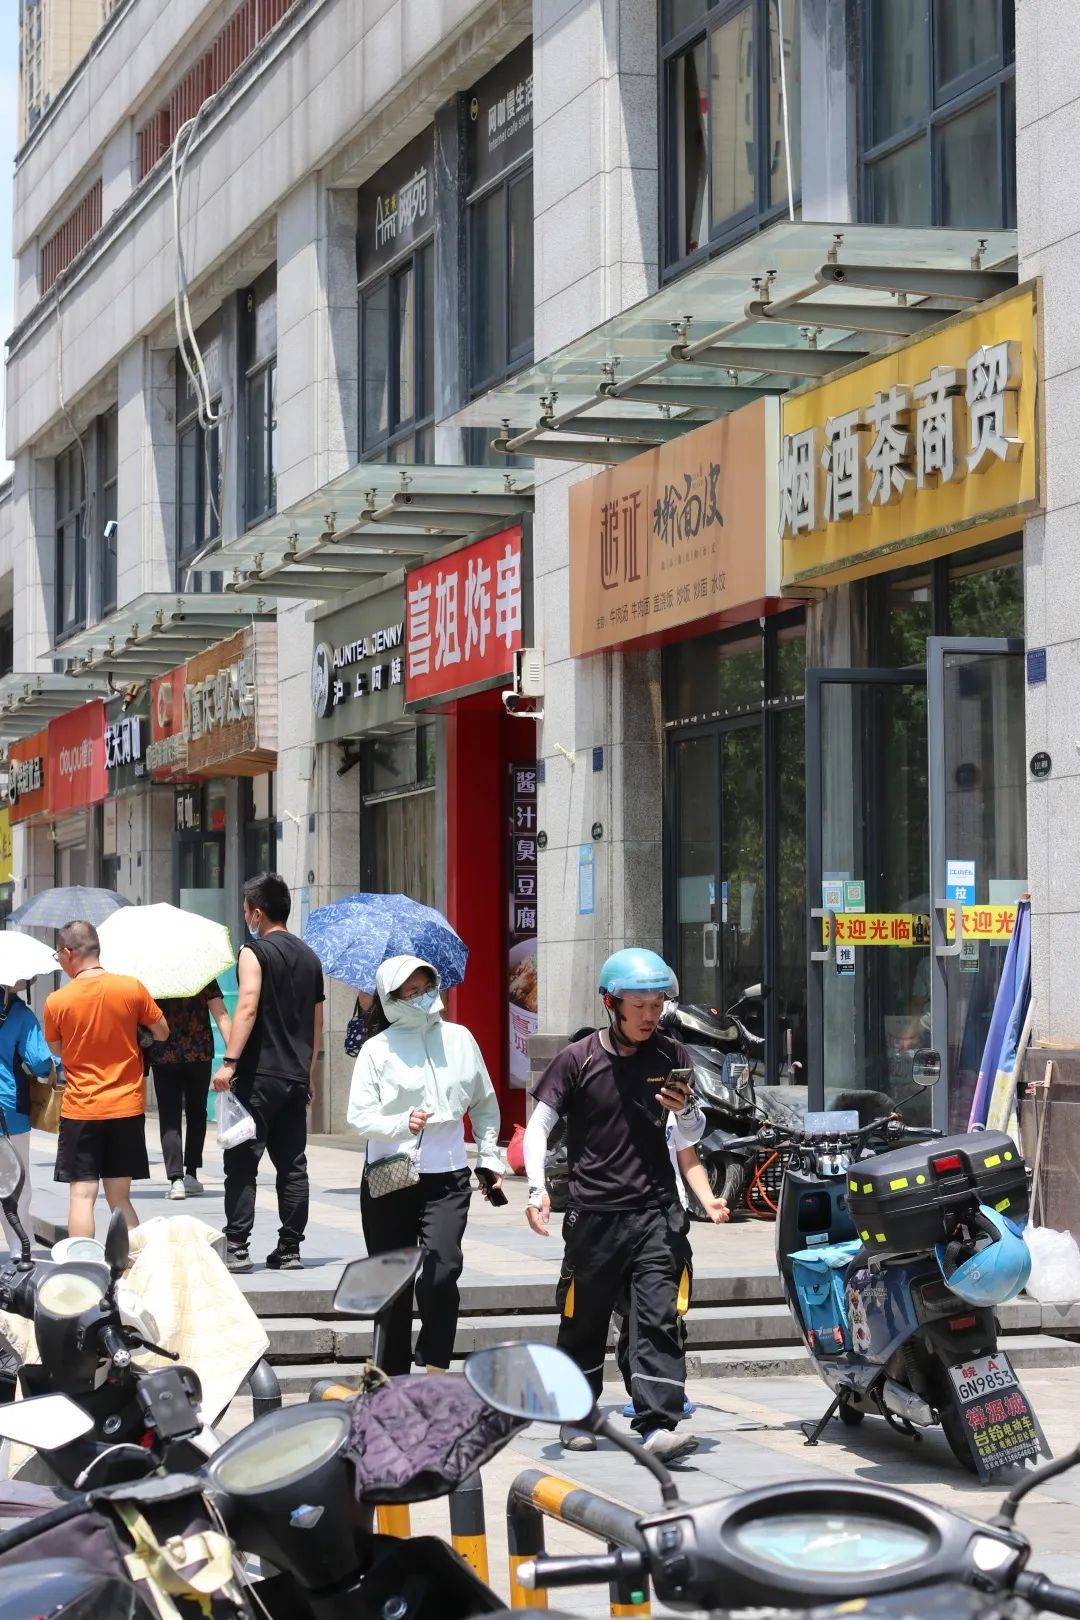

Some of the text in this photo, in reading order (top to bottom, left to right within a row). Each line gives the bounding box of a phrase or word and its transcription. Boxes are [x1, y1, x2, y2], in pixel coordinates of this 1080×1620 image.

[778, 340, 1023, 540] 烟酒茶商贸
[409, 543, 522, 679] 喜姐炸串
[610, 604, 629, 624] 牛肉汤
[631, 596, 651, 620] 牛肉面
[653, 589, 674, 613] 盖浇饭
[676, 583, 691, 605] 炒饭
[694, 577, 708, 600] 炒面
[711, 571, 726, 594] 水饺
[333, 622, 403, 668] AUNTEA JENNY
[516, 772, 537, 929] 酱汁臭豆腐
[955, 887, 967, 899] 拉
[825, 919, 911, 940] 欢迎光临
[840, 948, 851, 961] 推
[963, 943, 975, 956] 拉
[959, 1370, 1013, 1399] GN9853
[962, 1360, 999, 1379] 皖 A
[973, 1415, 1033, 1447] 台铃电动车
